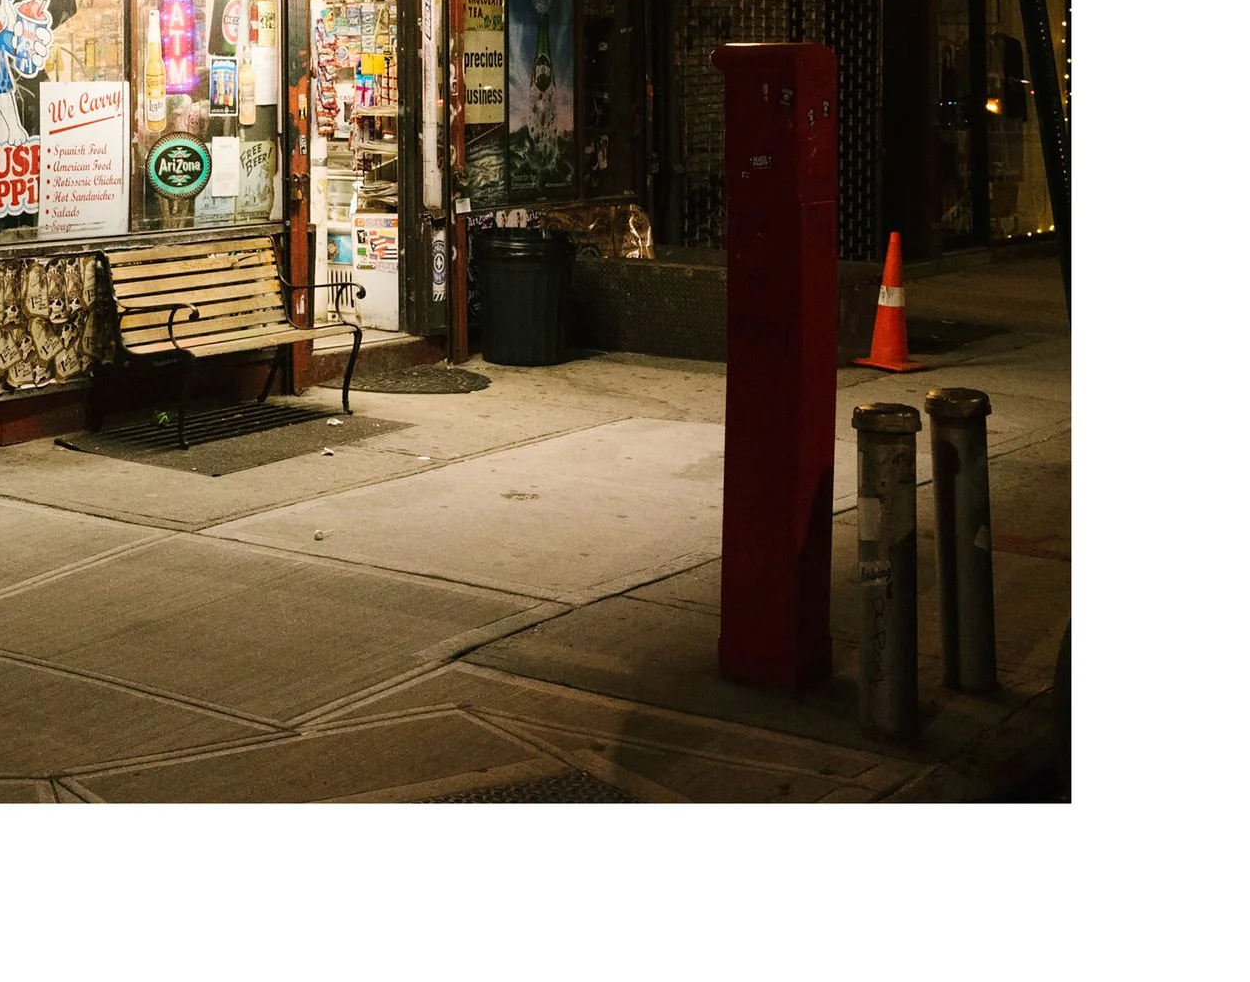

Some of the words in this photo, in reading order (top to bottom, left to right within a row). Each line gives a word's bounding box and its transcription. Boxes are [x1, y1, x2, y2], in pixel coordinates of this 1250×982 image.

[469, 6, 483, 19] TEA
[168, 1, 187, 85] ATM
[48, 98, 75, 123] We
[79, 90, 123, 114] Carry
[53, 144, 85, 158] Spanish
[88, 143, 107, 155] Food
[240, 143, 262, 169] FREE
[53, 161, 90, 172] American
[92, 159, 111, 171] Food
[158, 158, 201, 176] AriZona
[246, 146, 273, 177] BEER!
[53, 176, 91, 187] Rotisserie
[93, 174, 122, 186] Chicken
[53, 191, 69, 202] Hot
[71, 190, 115, 202] Sandwiches
[51, 206, 79, 218] Salads
